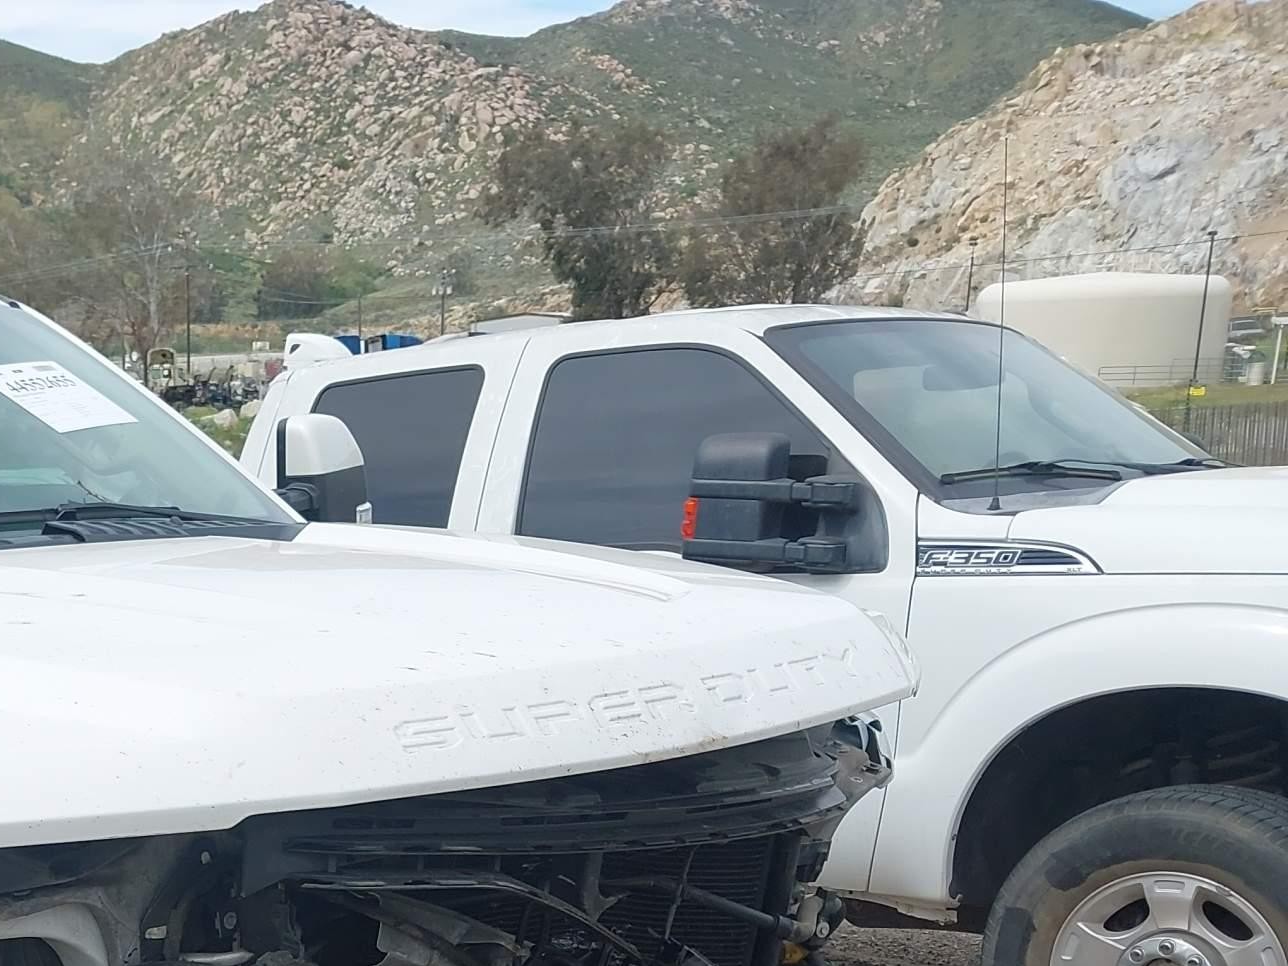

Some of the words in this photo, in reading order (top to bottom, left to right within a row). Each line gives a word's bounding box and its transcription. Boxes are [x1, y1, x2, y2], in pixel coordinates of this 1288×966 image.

[6, 375, 76, 393] 44552655
[919, 549, 1022, 568] F-350
[393, 683, 695, 753] SUPER
[700, 645, 859, 704] DUTY
